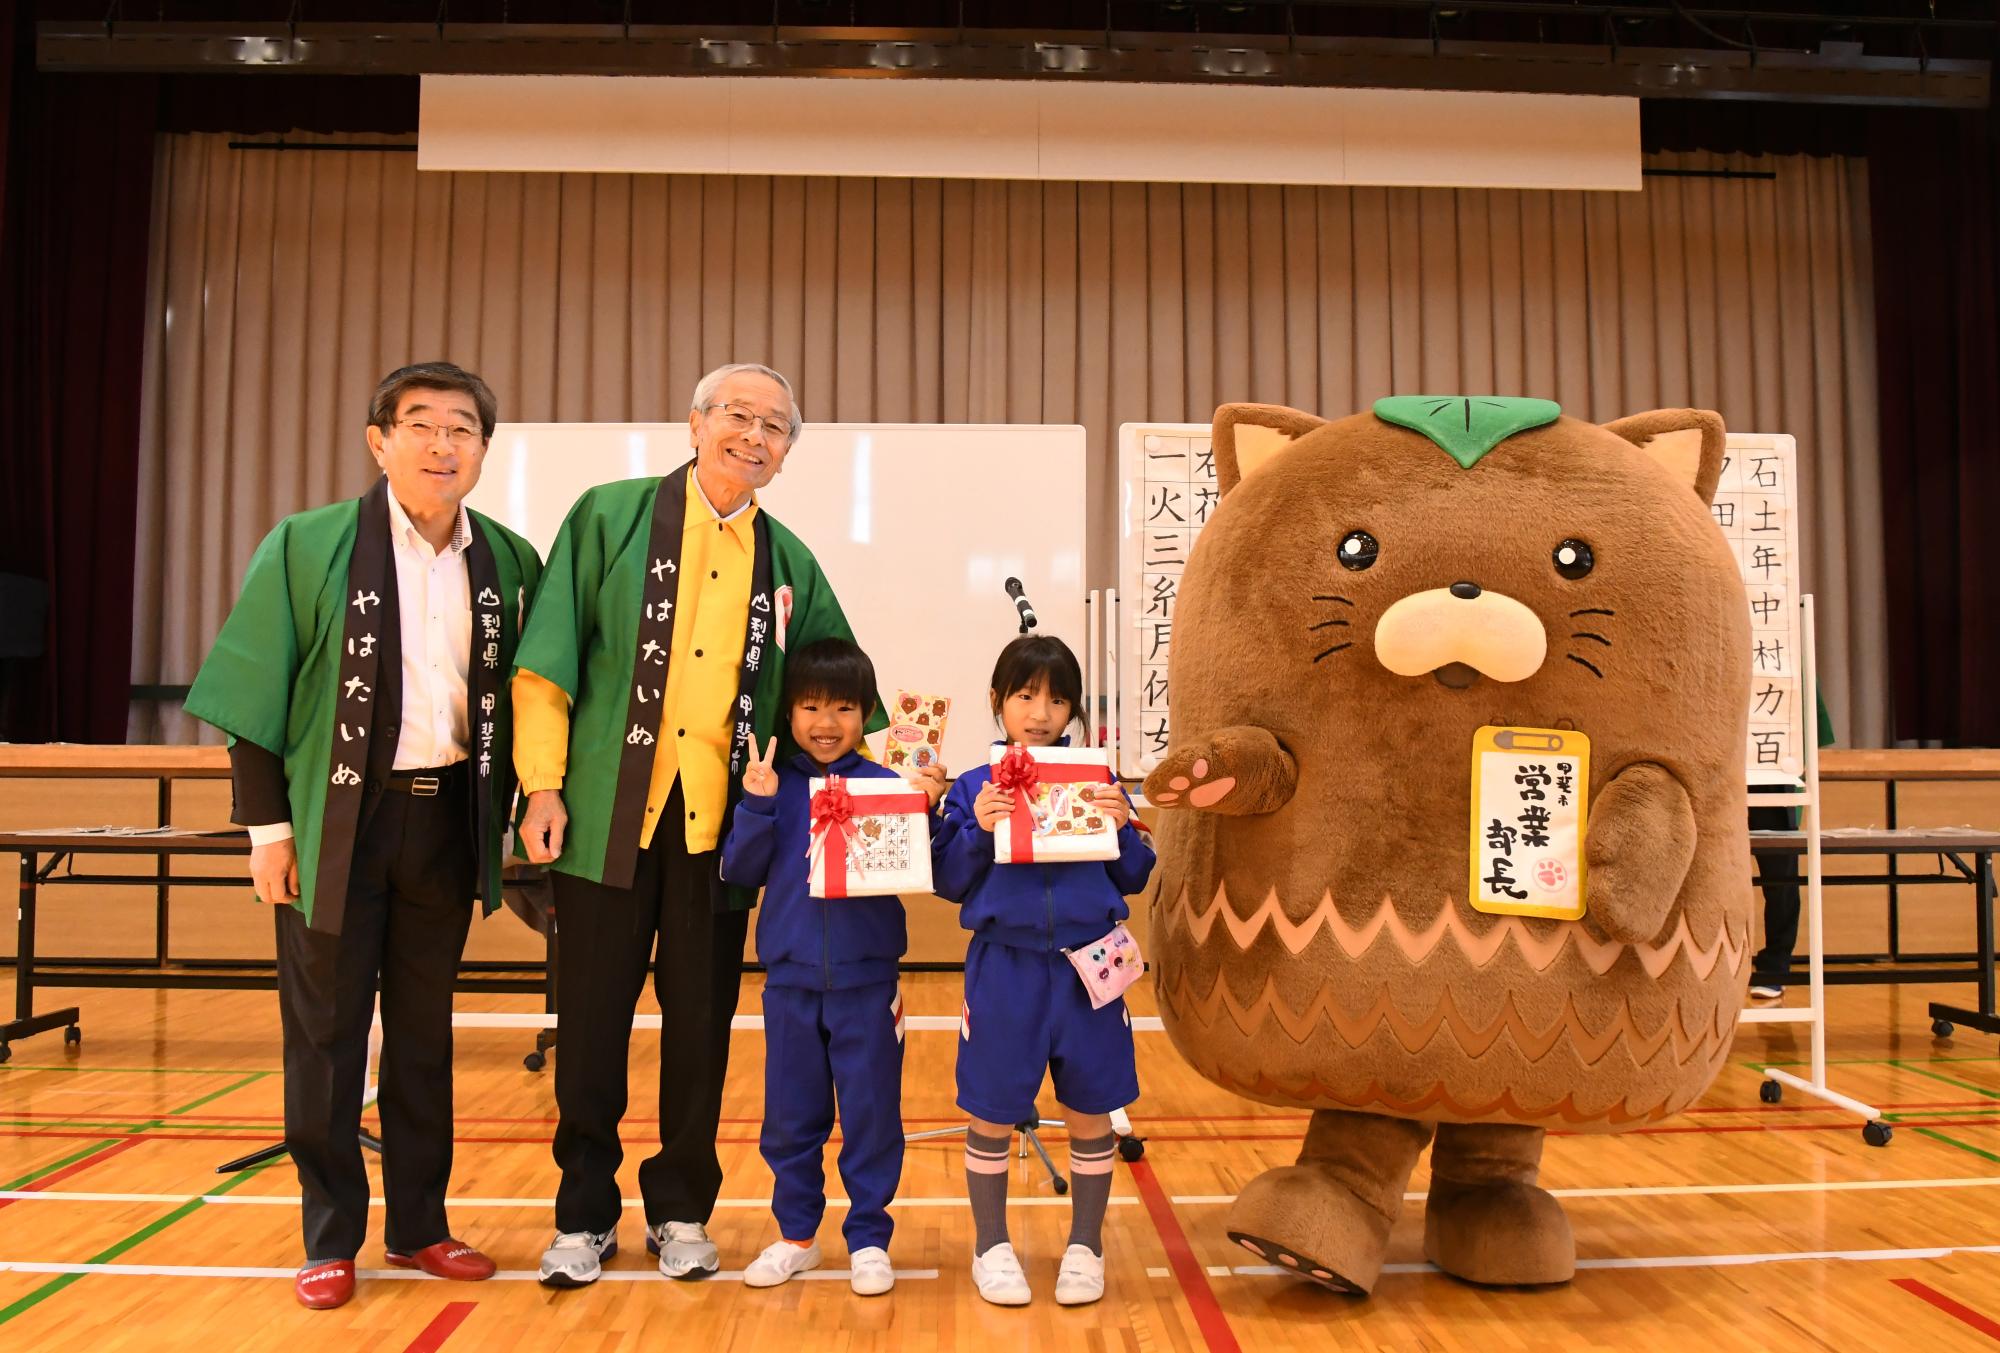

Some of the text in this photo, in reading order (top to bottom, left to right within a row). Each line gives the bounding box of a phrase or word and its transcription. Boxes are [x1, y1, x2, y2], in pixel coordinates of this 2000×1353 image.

[477, 586, 501, 669] 山梨県
[626, 558, 677, 746] やはたいぬ
[745, 592, 770, 672] 山梨県
[1750, 456, 1786, 766] 石土年中村力百
[331, 589, 381, 786] やはたいぬ
[1514, 764, 1552, 848] 営業
[1555, 762, 1573, 807] 甲斐市
[1483, 818, 1529, 900] 部長
